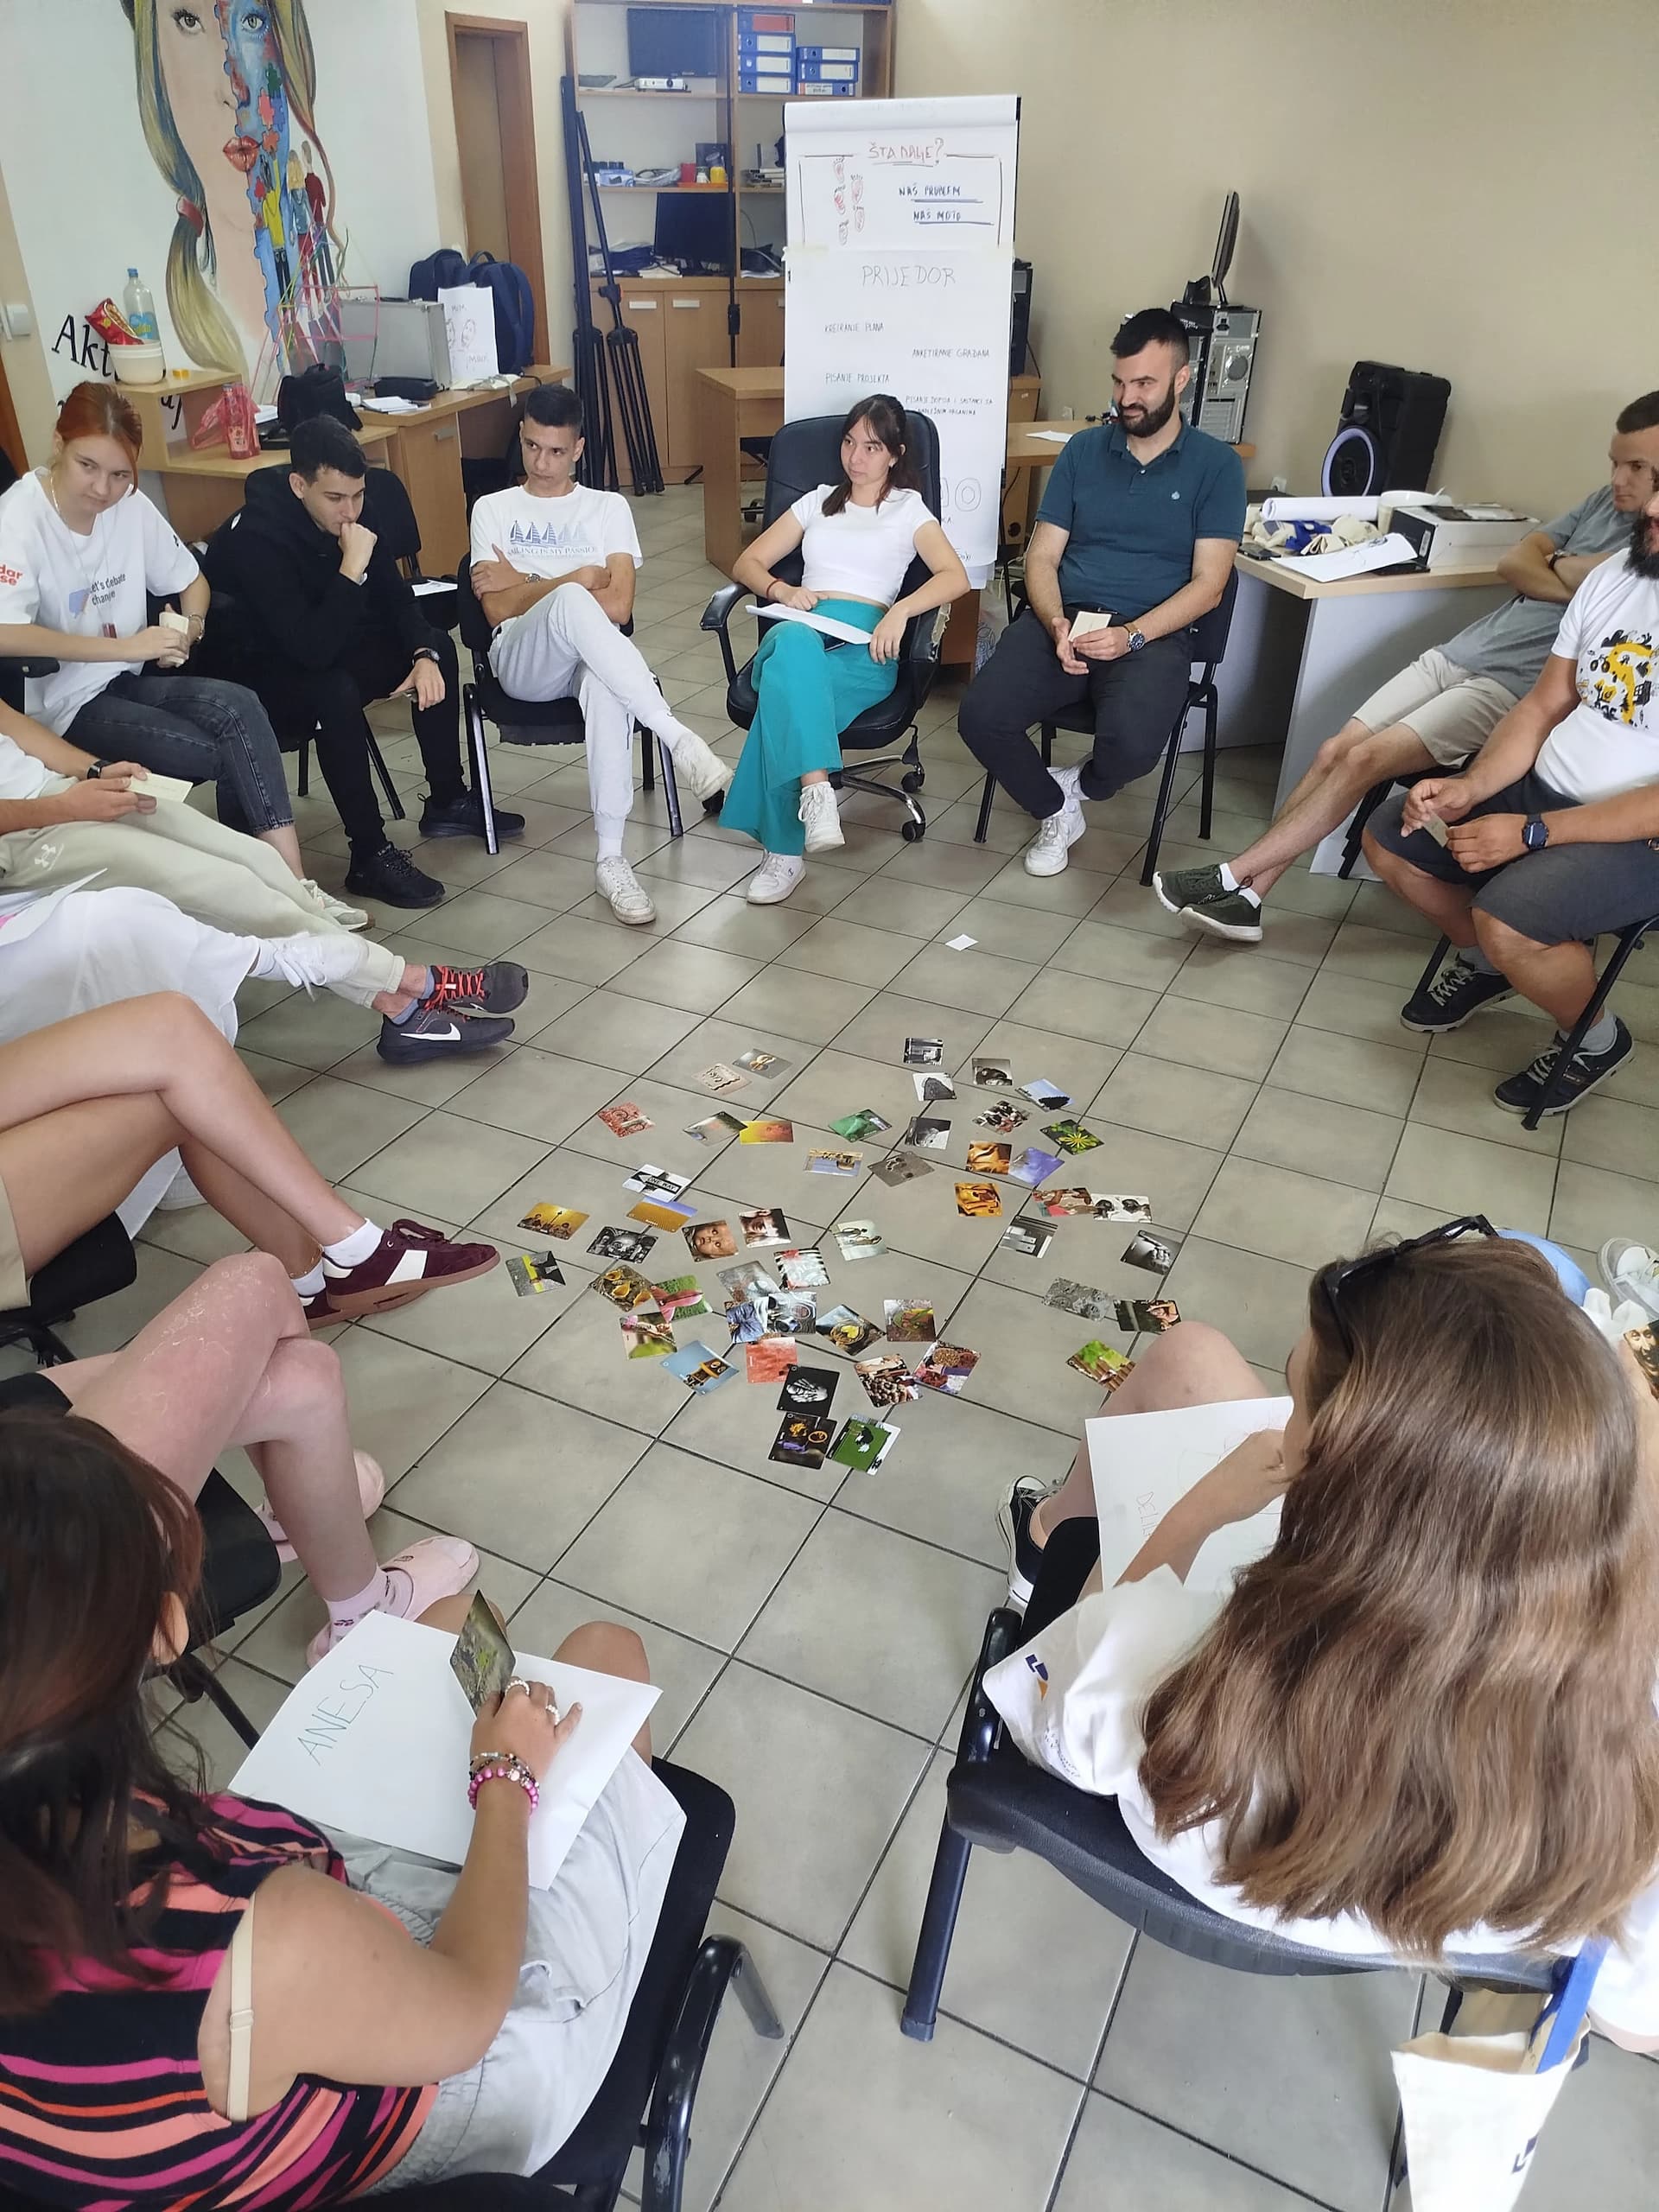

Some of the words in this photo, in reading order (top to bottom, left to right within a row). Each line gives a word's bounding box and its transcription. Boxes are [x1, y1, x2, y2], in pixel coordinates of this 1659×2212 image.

[868, 142, 896, 159] ŠTA
[899, 182, 918, 196] NAŠ
[913, 208, 931, 220] NAŠ
[937, 211, 961, 221] MOTO
[862, 265, 957, 287] PRIJEDOR
[825, 372, 851, 384] PISANJE
[857, 373, 890, 384] PROJEKTA
[105, 573, 126, 588] debate
[297, 1664, 394, 1766] ANESA
